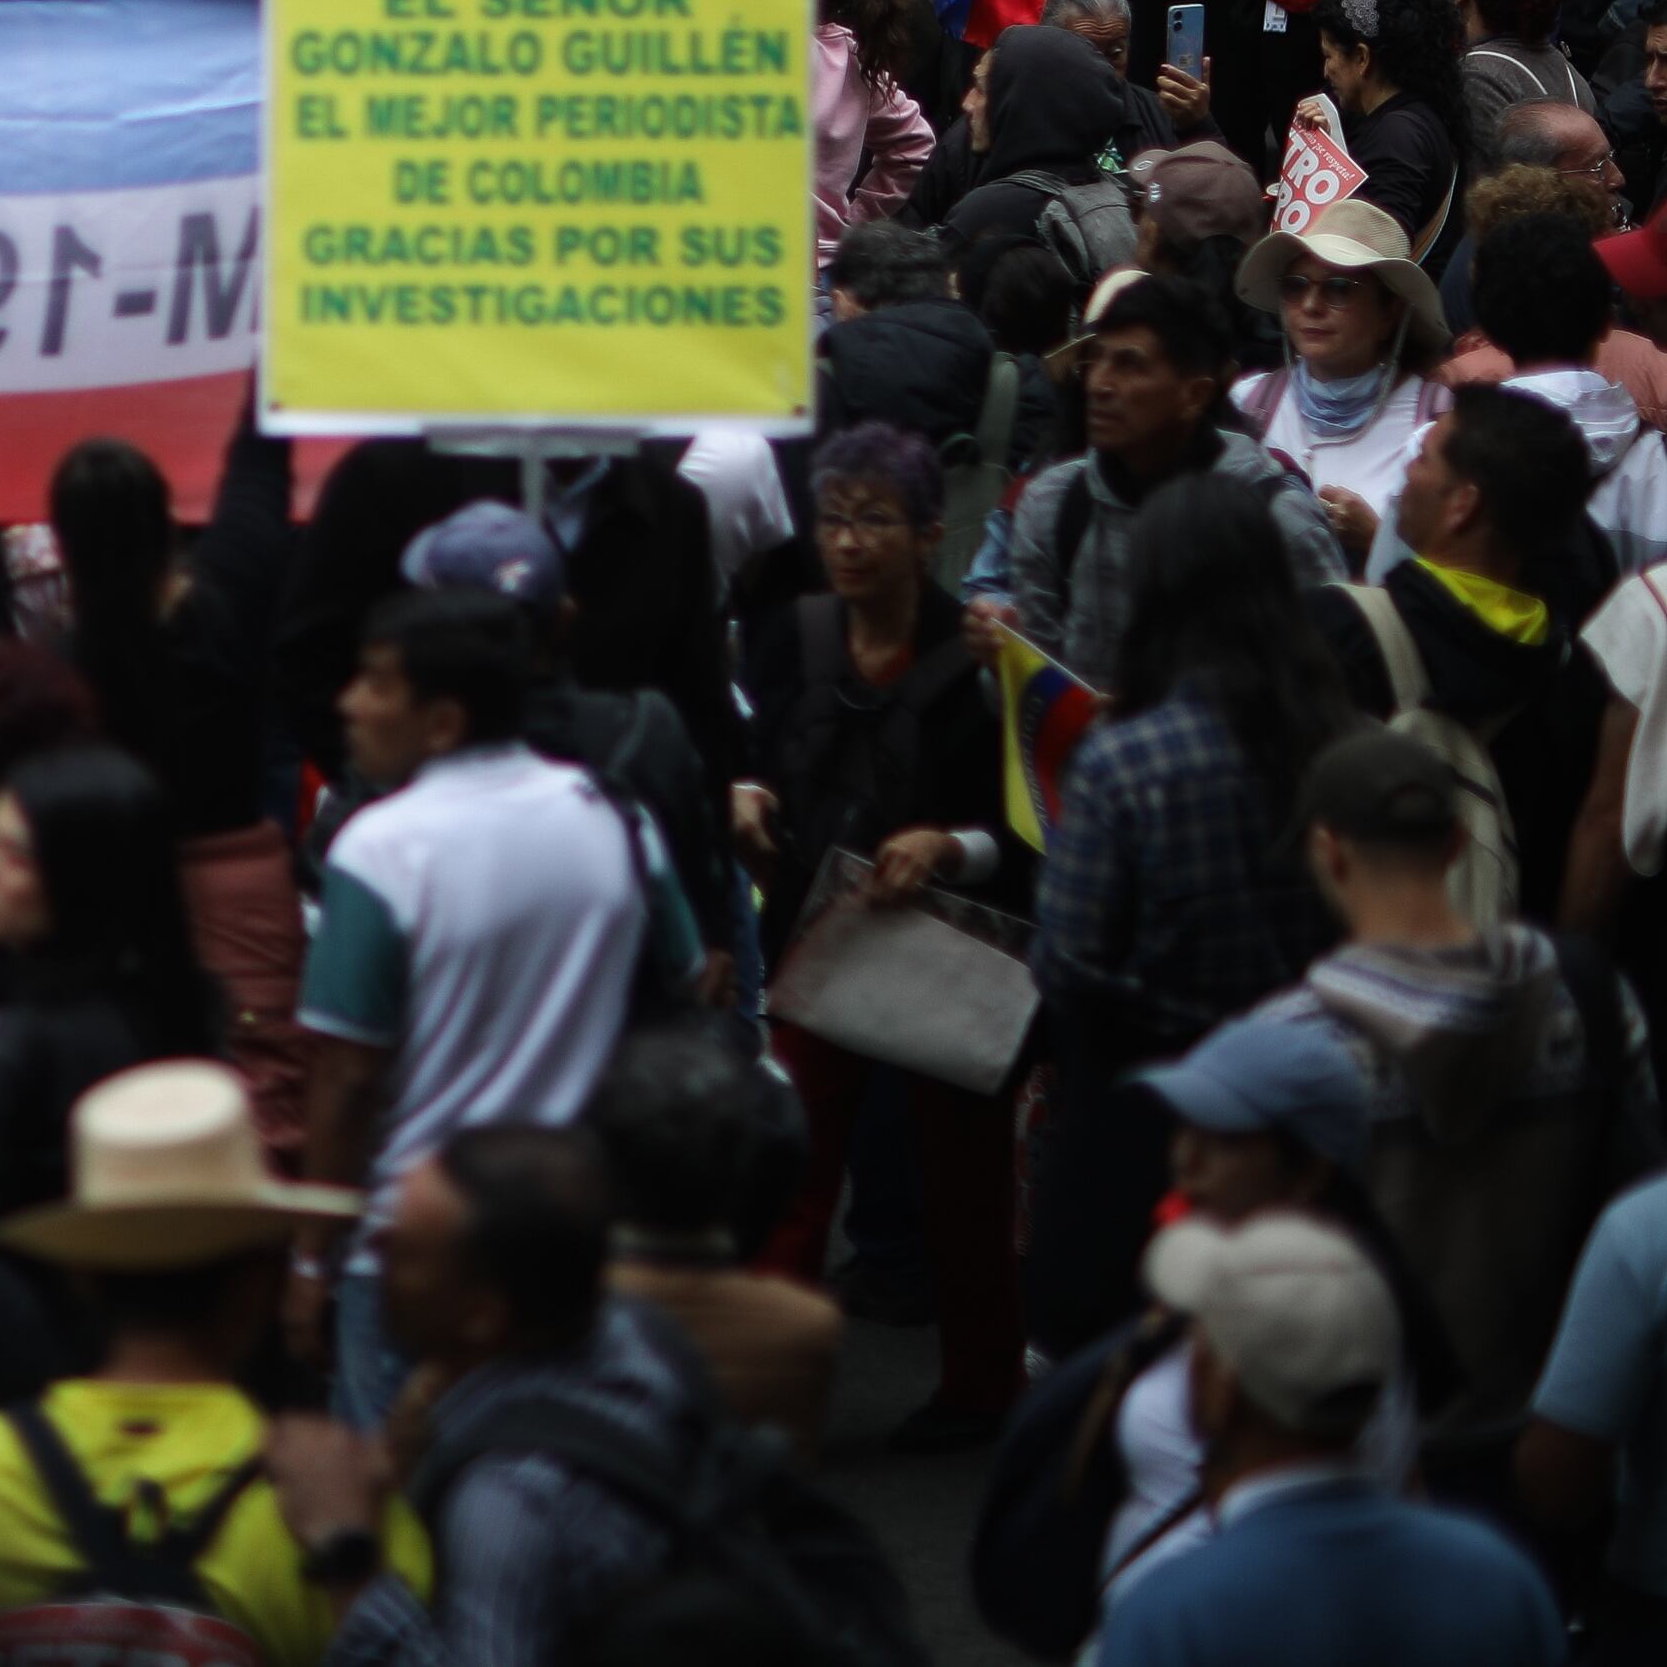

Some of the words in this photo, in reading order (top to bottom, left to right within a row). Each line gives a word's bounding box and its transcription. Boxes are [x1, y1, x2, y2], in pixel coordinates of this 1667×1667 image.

[291, 30, 544, 77] GONZALO
[561, 18, 788, 76] GUILLÉN
[297, 94, 348, 138] EL
[366, 94, 521, 138] MEJOR
[535, 94, 803, 137] PERIODISTA
[394, 159, 451, 205] DE
[466, 159, 704, 205] COLOMBIA
[303, 225, 535, 267] GRACIAS
[555, 225, 661, 267] POR
[680, 225, 785, 267] SUS
[300, 285, 787, 327] INVESTIGACIONES
